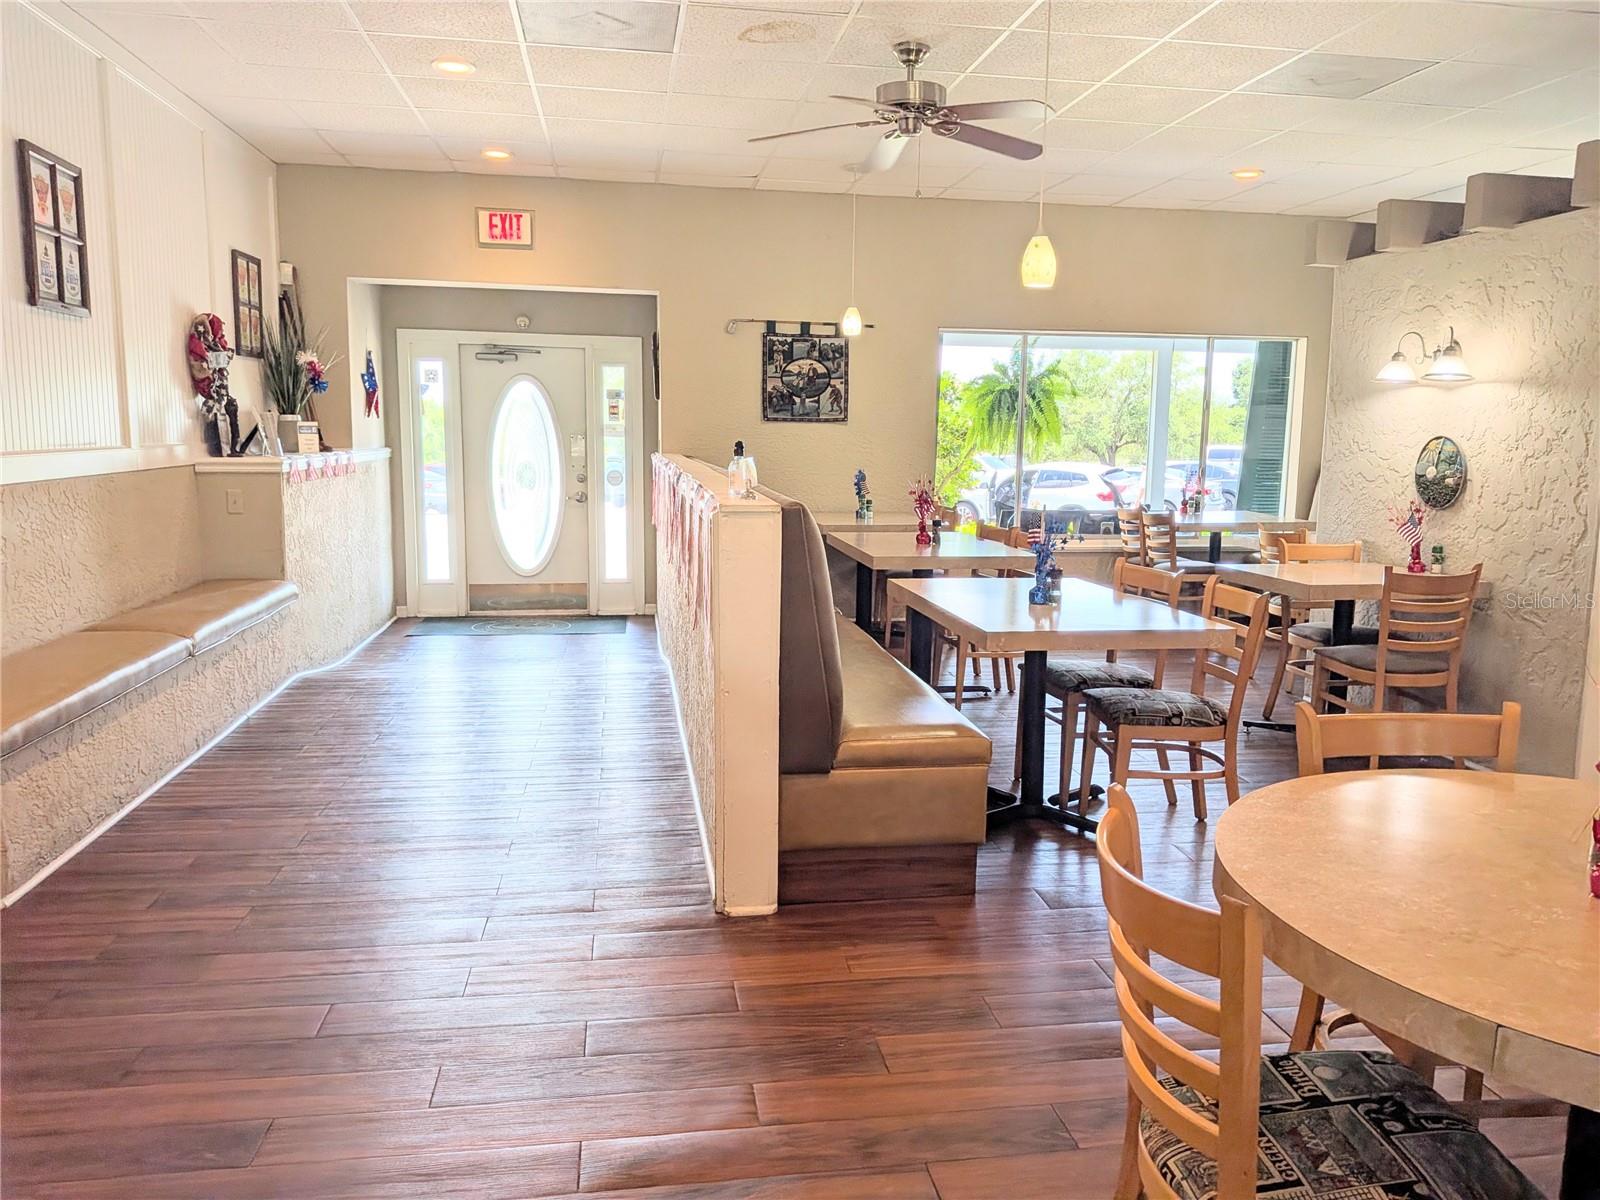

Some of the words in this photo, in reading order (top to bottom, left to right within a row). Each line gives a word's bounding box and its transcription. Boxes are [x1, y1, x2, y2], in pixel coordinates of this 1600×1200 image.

[488, 212, 523, 241] EXIT
[1277, 1060, 1323, 1097] Birdie
[1258, 1136, 1298, 1181] GREEN
